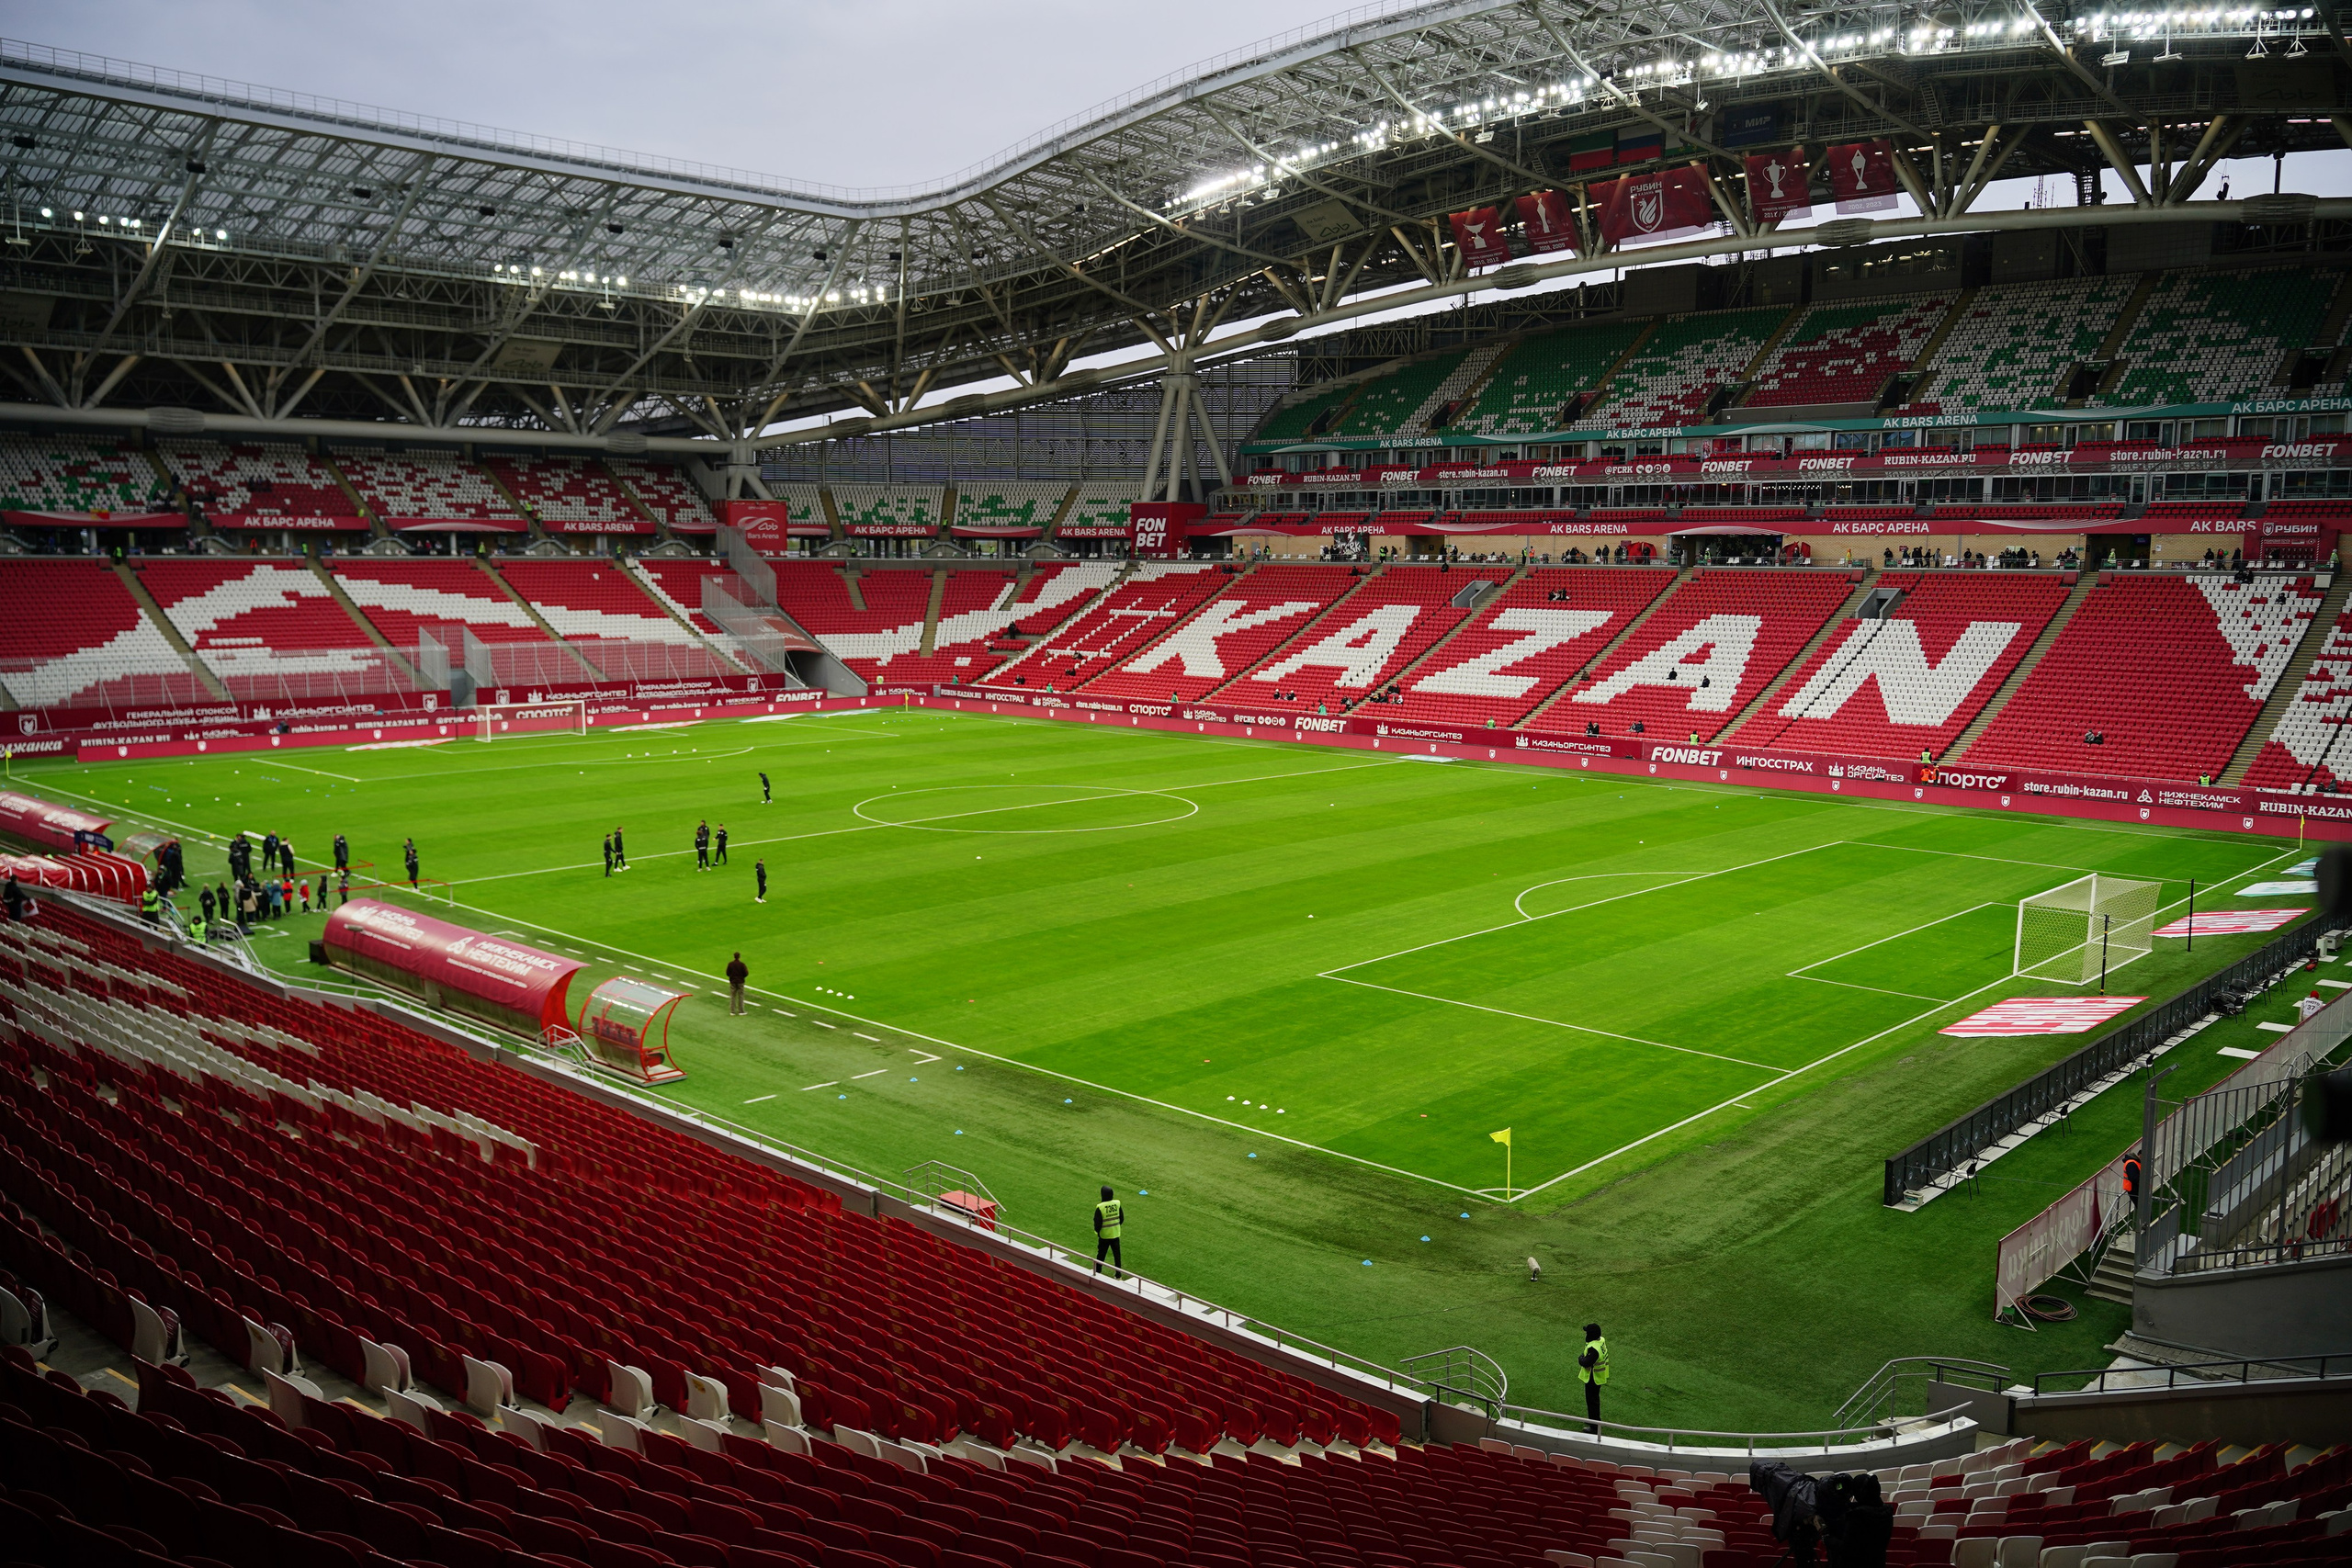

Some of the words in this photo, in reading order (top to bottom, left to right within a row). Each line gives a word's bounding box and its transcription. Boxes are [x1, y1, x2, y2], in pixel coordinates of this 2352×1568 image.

[1745, 116, 1771, 128] МИР
[1630, 181, 1662, 193] РУБИН
[2232, 402, 2251, 413] АК
[2256, 400, 2296, 412] БАРС
[2300, 399, 2352, 411] АРЕНА
[1883, 418, 1899, 427] AK
[1902, 417, 1933, 427] BARS
[1936, 415, 1978, 425] ARENA
[1606, 430, 1619, 439] АК
[1622, 429, 1646, 438] БАРС
[1649, 427, 1682, 436] АРЕНА
[1379, 440, 1390, 448] AK
[1392, 439, 1413, 447] BARS
[1415, 437, 1442, 446] ARENA
[2109, 448, 2226, 461] store.rubin-kazan.ru
[2261, 444, 2337, 458] FONBET
[1799, 457, 1854, 470] FONBET
[1884, 454, 1976, 466] RUBIN-KAZAN.RU
[2008, 451, 2074, 465] FONBET
[1532, 465, 1577, 477] FONBET
[1604, 466, 1633, 476] @FCRK
[1701, 460, 1752, 472] FONBET
[1303, 474, 1361, 483] RUBIN-KAZAN.RU
[1381, 471, 1419, 481] FONBET
[1439, 468, 1508, 479] store.rubin-kazan.ru
[1248, 475, 1282, 485] FONBET
[244, 516, 261, 526] АК
[263, 516, 294, 527] БАРС
[296, 517, 335, 528] АРЕНА
[563, 522, 577, 531] AK
[579, 522, 603, 531] BARS
[604, 523, 635, 532] ARENA
[1136, 518, 1166, 531] FON
[2190, 521, 2211, 532] AK
[2215, 521, 2256, 532] BARS
[895, 526, 926, 535] АРЕНА
[1098, 528, 1126, 536] ARENA
[1321, 525, 1332, 535] АК
[1357, 525, 1385, 535] АРЕНА
[1550, 525, 1564, 534] AK
[1566, 525, 1591, 534] BARS
[1593, 525, 1627, 534] ARENA
[1833, 524, 1849, 534] АК
[1852, 524, 1884, 534] БАРС
[1887, 524, 1929, 534] АРЕНА
[1136, 533, 1166, 547] BET
[1122, 599, 2021, 727] KAZAN
[986, 692, 1025, 704] ИНГОССТРАХ
[127, 708, 195, 720] ГЕНЕРАЛЬНЫЙ
[196, 706, 239, 717] СПОНСОР
[1194, 709, 1216, 717] КАЗАНЬ
[1194, 715, 1227, 723] ОРГСИНТЕЗ
[1234, 715, 1256, 724] @FCRK
[1295, 716, 1347, 733] FONBET
[1391, 728, 1463, 739] КАЗАНЬОРГСИНТЕЗ
[1532, 739, 1611, 752] КАЗАНЬОРГСИНТЕЗ
[1651, 747, 1723, 766] FONBET
[1736, 755, 1814, 773] ИНГОССТРАХ
[1848, 764, 1886, 774] КАЗАНЬ
[1848, 772, 1905, 782] ОРГСИНТЕЗ
[2024, 781, 2128, 800] store.rubin-kazan.ru
[2159, 791, 2241, 804] НИЖНЕКАМСК
[2159, 797, 2223, 809] НЕФТЕХИМ
[465, 947, 533, 976] НЕФТЕХИМ
[475, 941, 561, 971] НИЖНЕКАМСК
